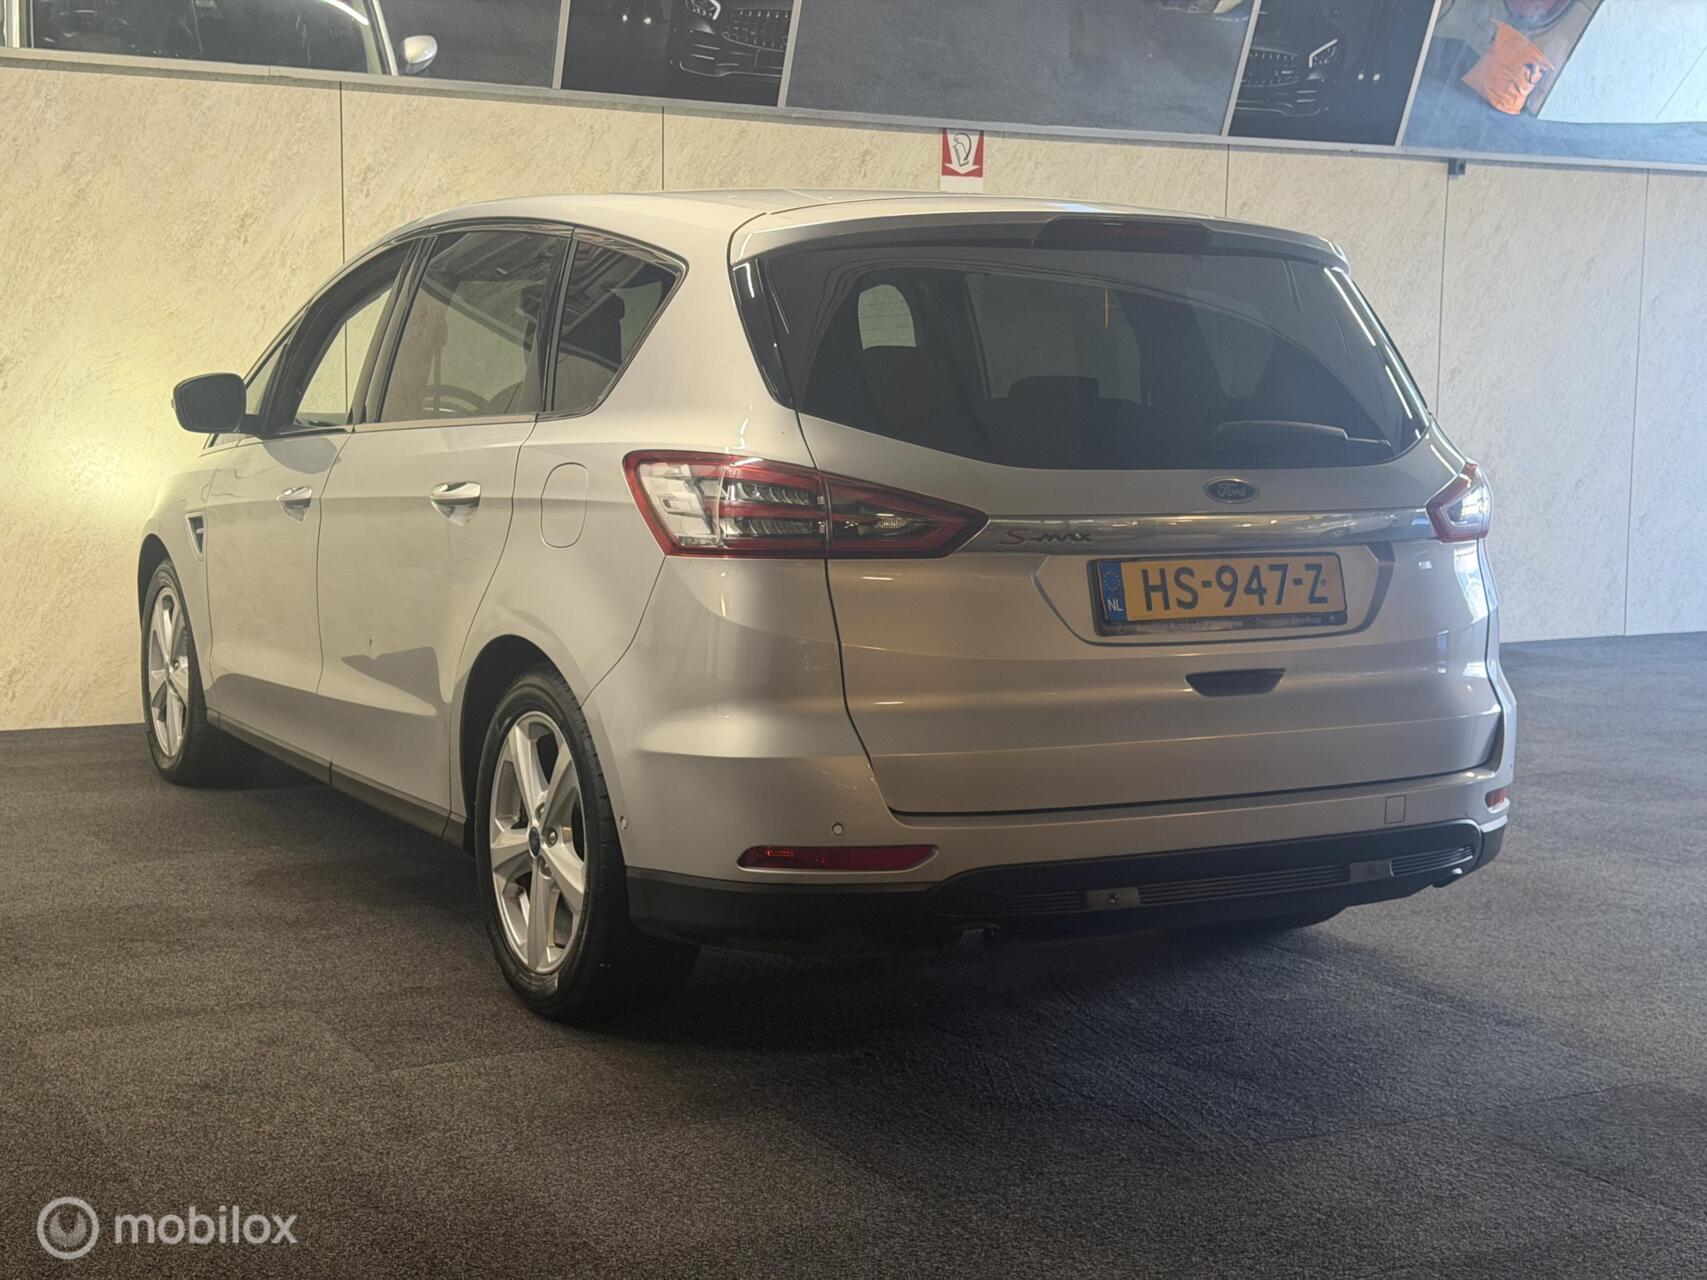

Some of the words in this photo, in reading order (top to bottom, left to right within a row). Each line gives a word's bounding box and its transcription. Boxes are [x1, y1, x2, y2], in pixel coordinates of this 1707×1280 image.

[1216, 482, 1250, 498] Ford
[1141, 563, 1329, 612] HS-947-Z
[1107, 598, 1124, 611] NL
